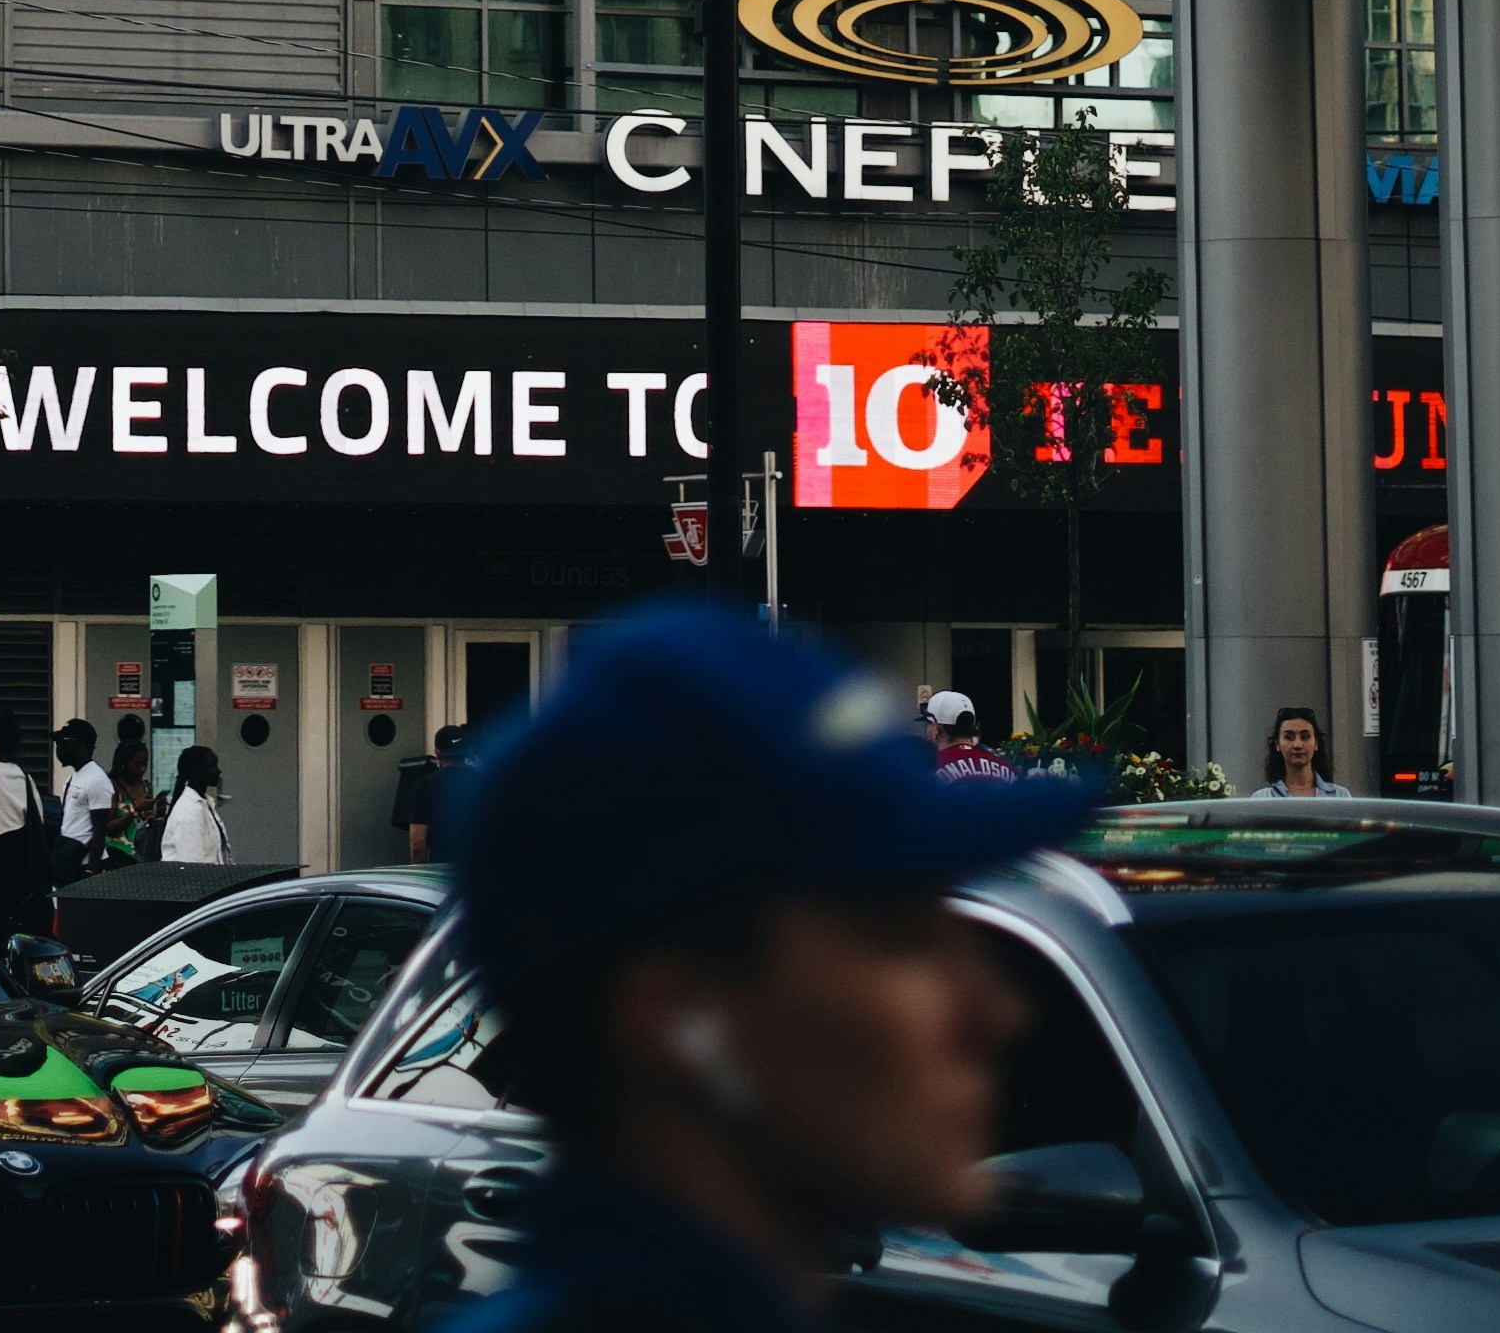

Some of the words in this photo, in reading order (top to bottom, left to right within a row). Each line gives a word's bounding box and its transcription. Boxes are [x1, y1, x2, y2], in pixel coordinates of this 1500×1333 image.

[220, 113, 384, 163] ULTRA
[377, 106, 549, 182] AVX
[604, 107, 1178, 212] CNEPLE
[815, 363, 969, 470] 10
[1022, 381, 1182, 464] TE
[530, 559, 630, 587] Dundas
[1400, 572, 1428, 588] 4567
[221, 989, 262, 1012] Litter
